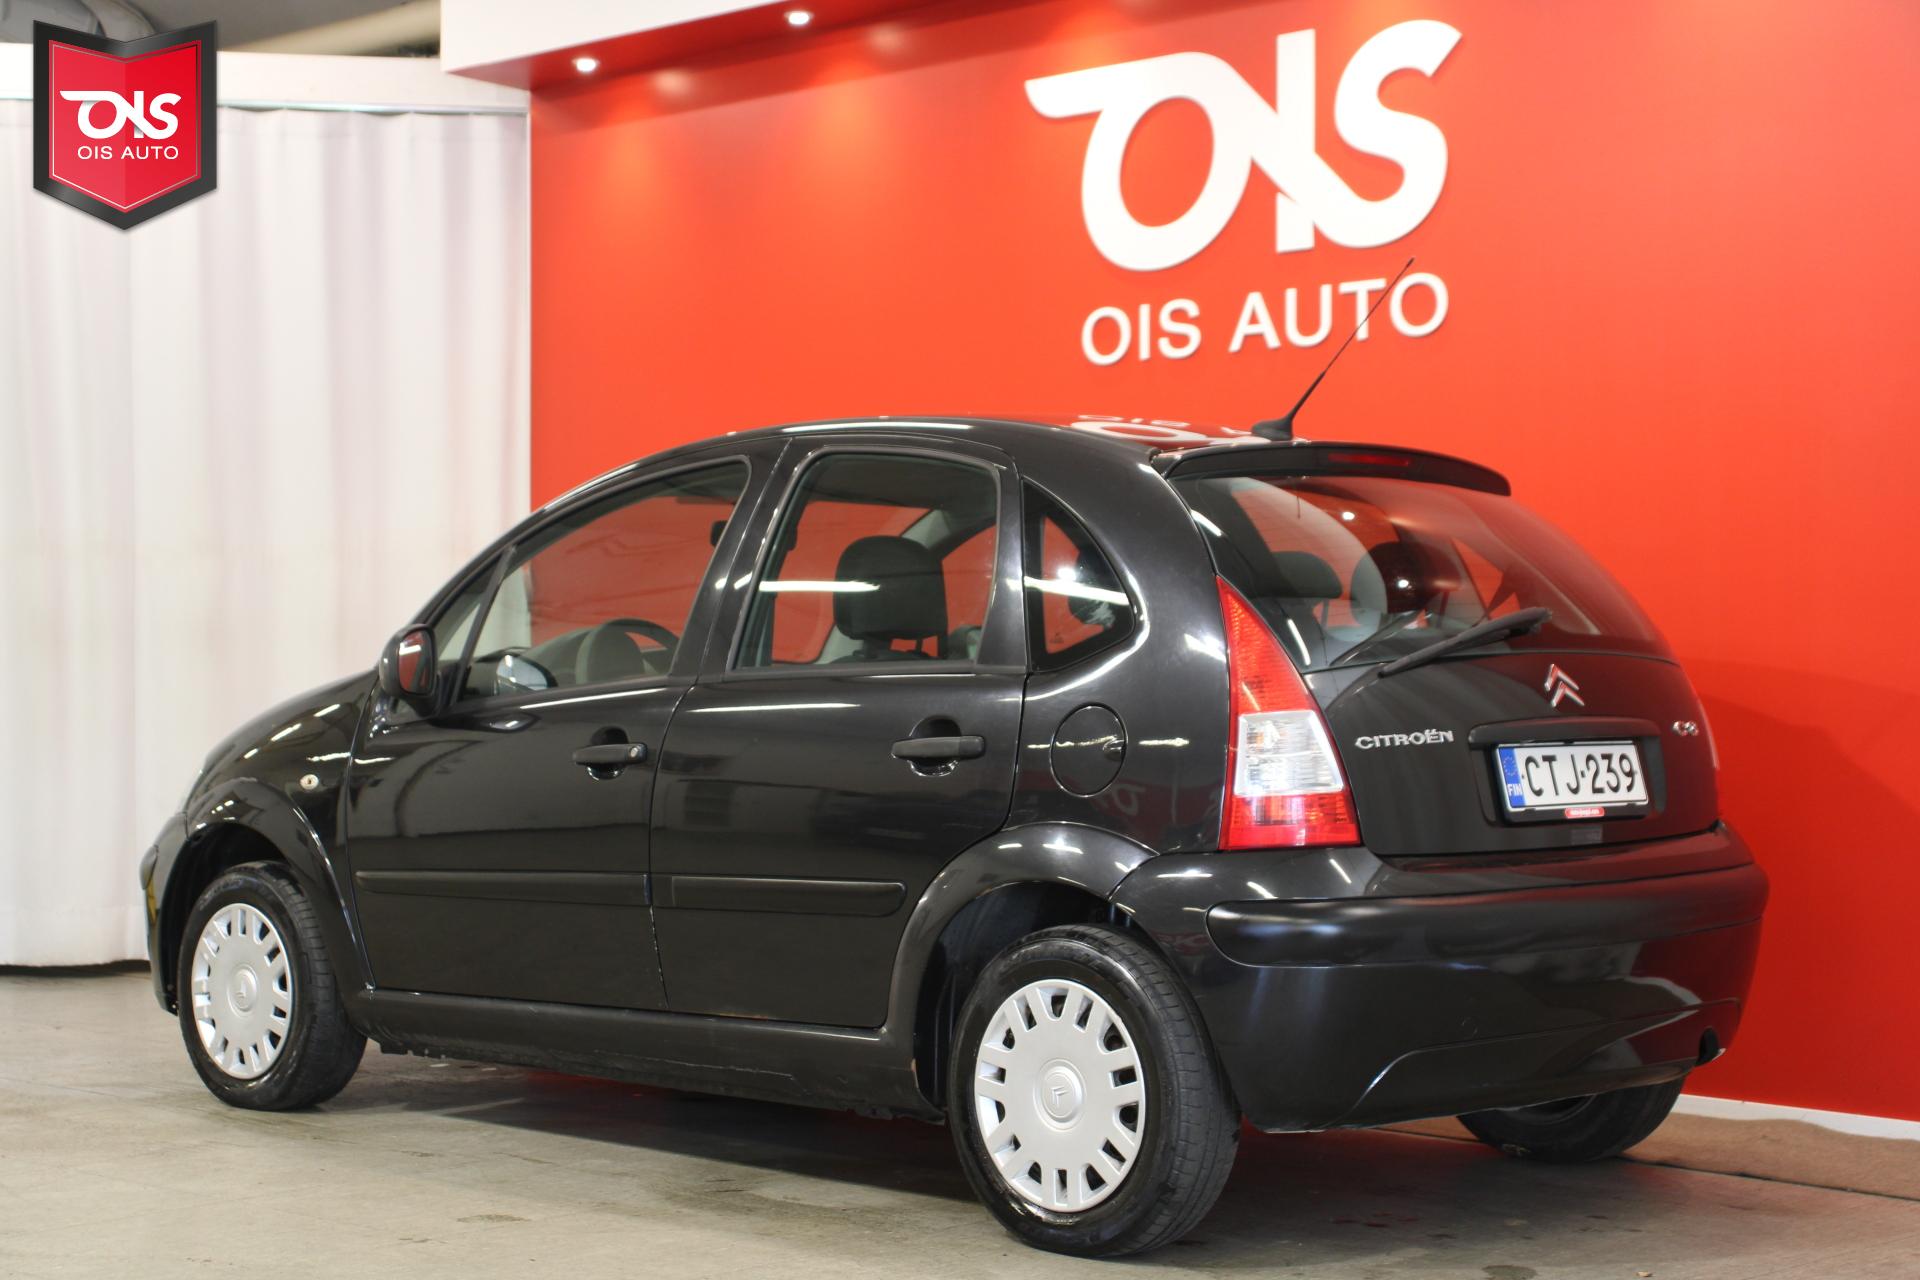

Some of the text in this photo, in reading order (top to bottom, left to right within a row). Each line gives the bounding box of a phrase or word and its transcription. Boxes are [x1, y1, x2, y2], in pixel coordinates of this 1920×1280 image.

[1024, 19, 1462, 271] OIS
[1081, 272, 1449, 366] OIS AUTO
[1507, 783, 1523, 796] FIN
[1525, 753, 1634, 797] CTJ-239
